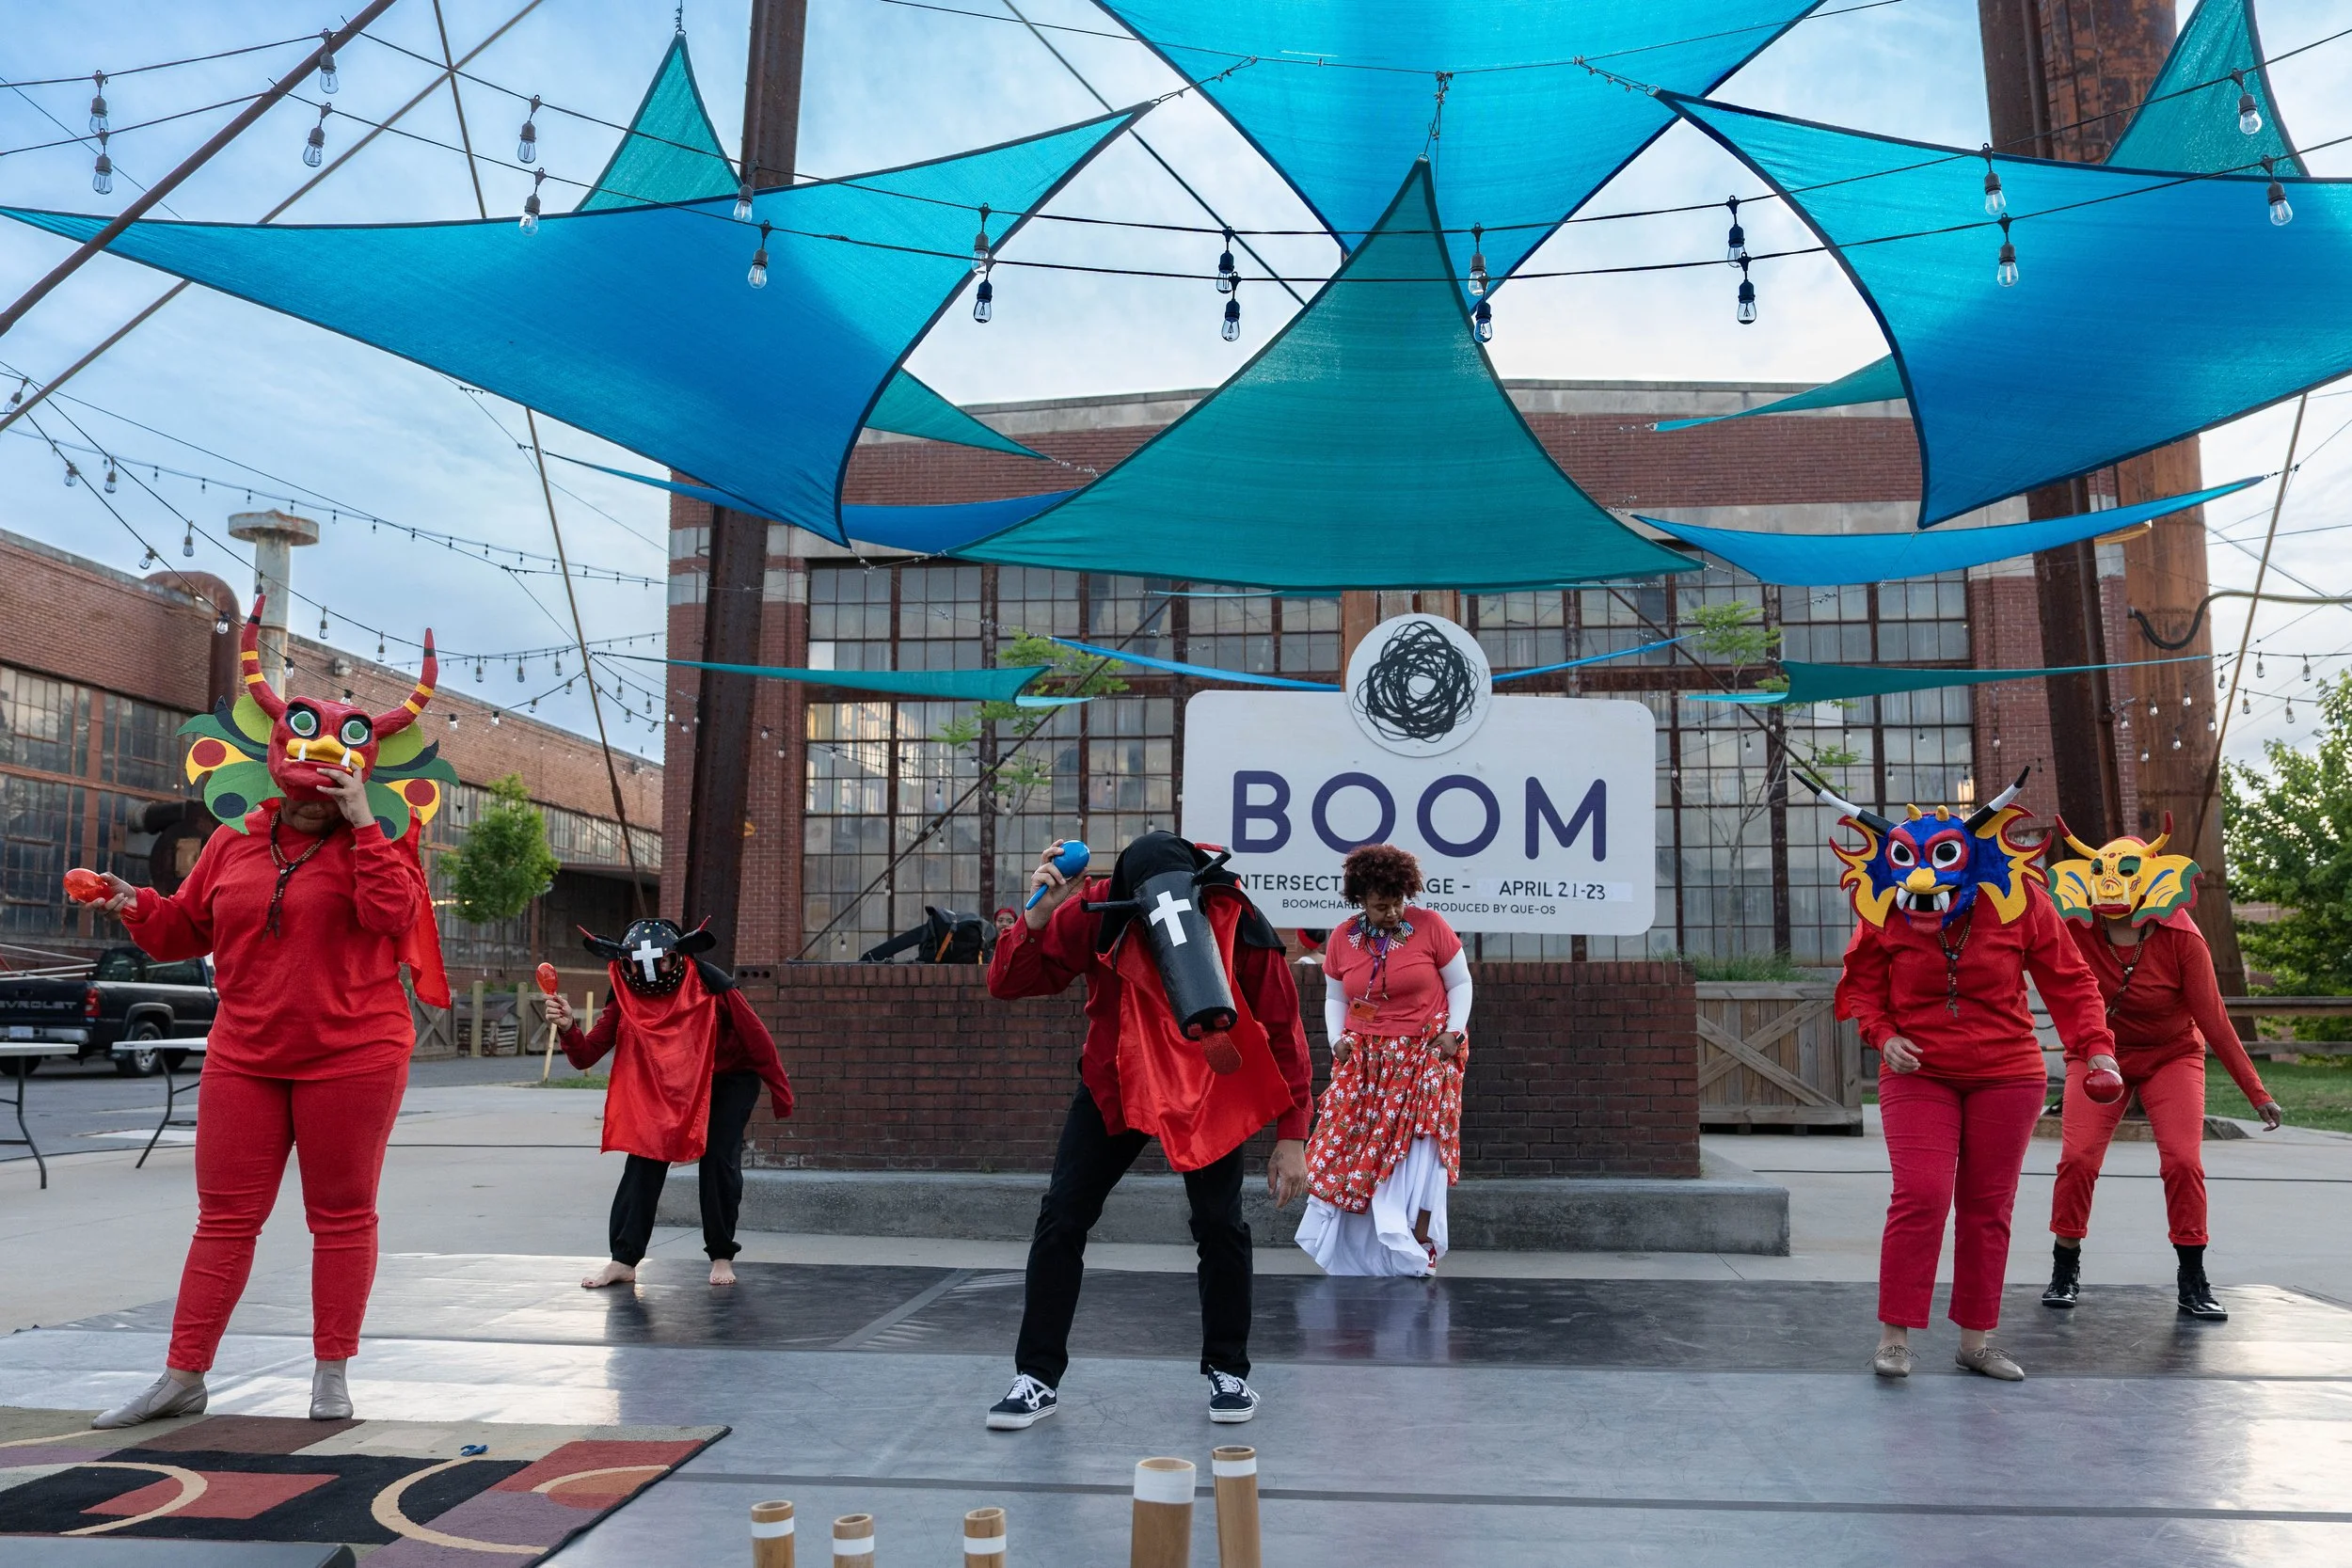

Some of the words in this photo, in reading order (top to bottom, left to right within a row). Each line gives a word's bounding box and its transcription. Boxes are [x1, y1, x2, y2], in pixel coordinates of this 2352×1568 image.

[1232, 769, 1607, 863] BOOM
[1239, 874, 1343, 892] NTERSECT
[1499, 879, 1553, 897] APRIL
[1426, 902, 1489, 913] PRODUCED
[1493, 904, 1508, 913] BY
[1510, 904, 1556, 915] QUE-OS
